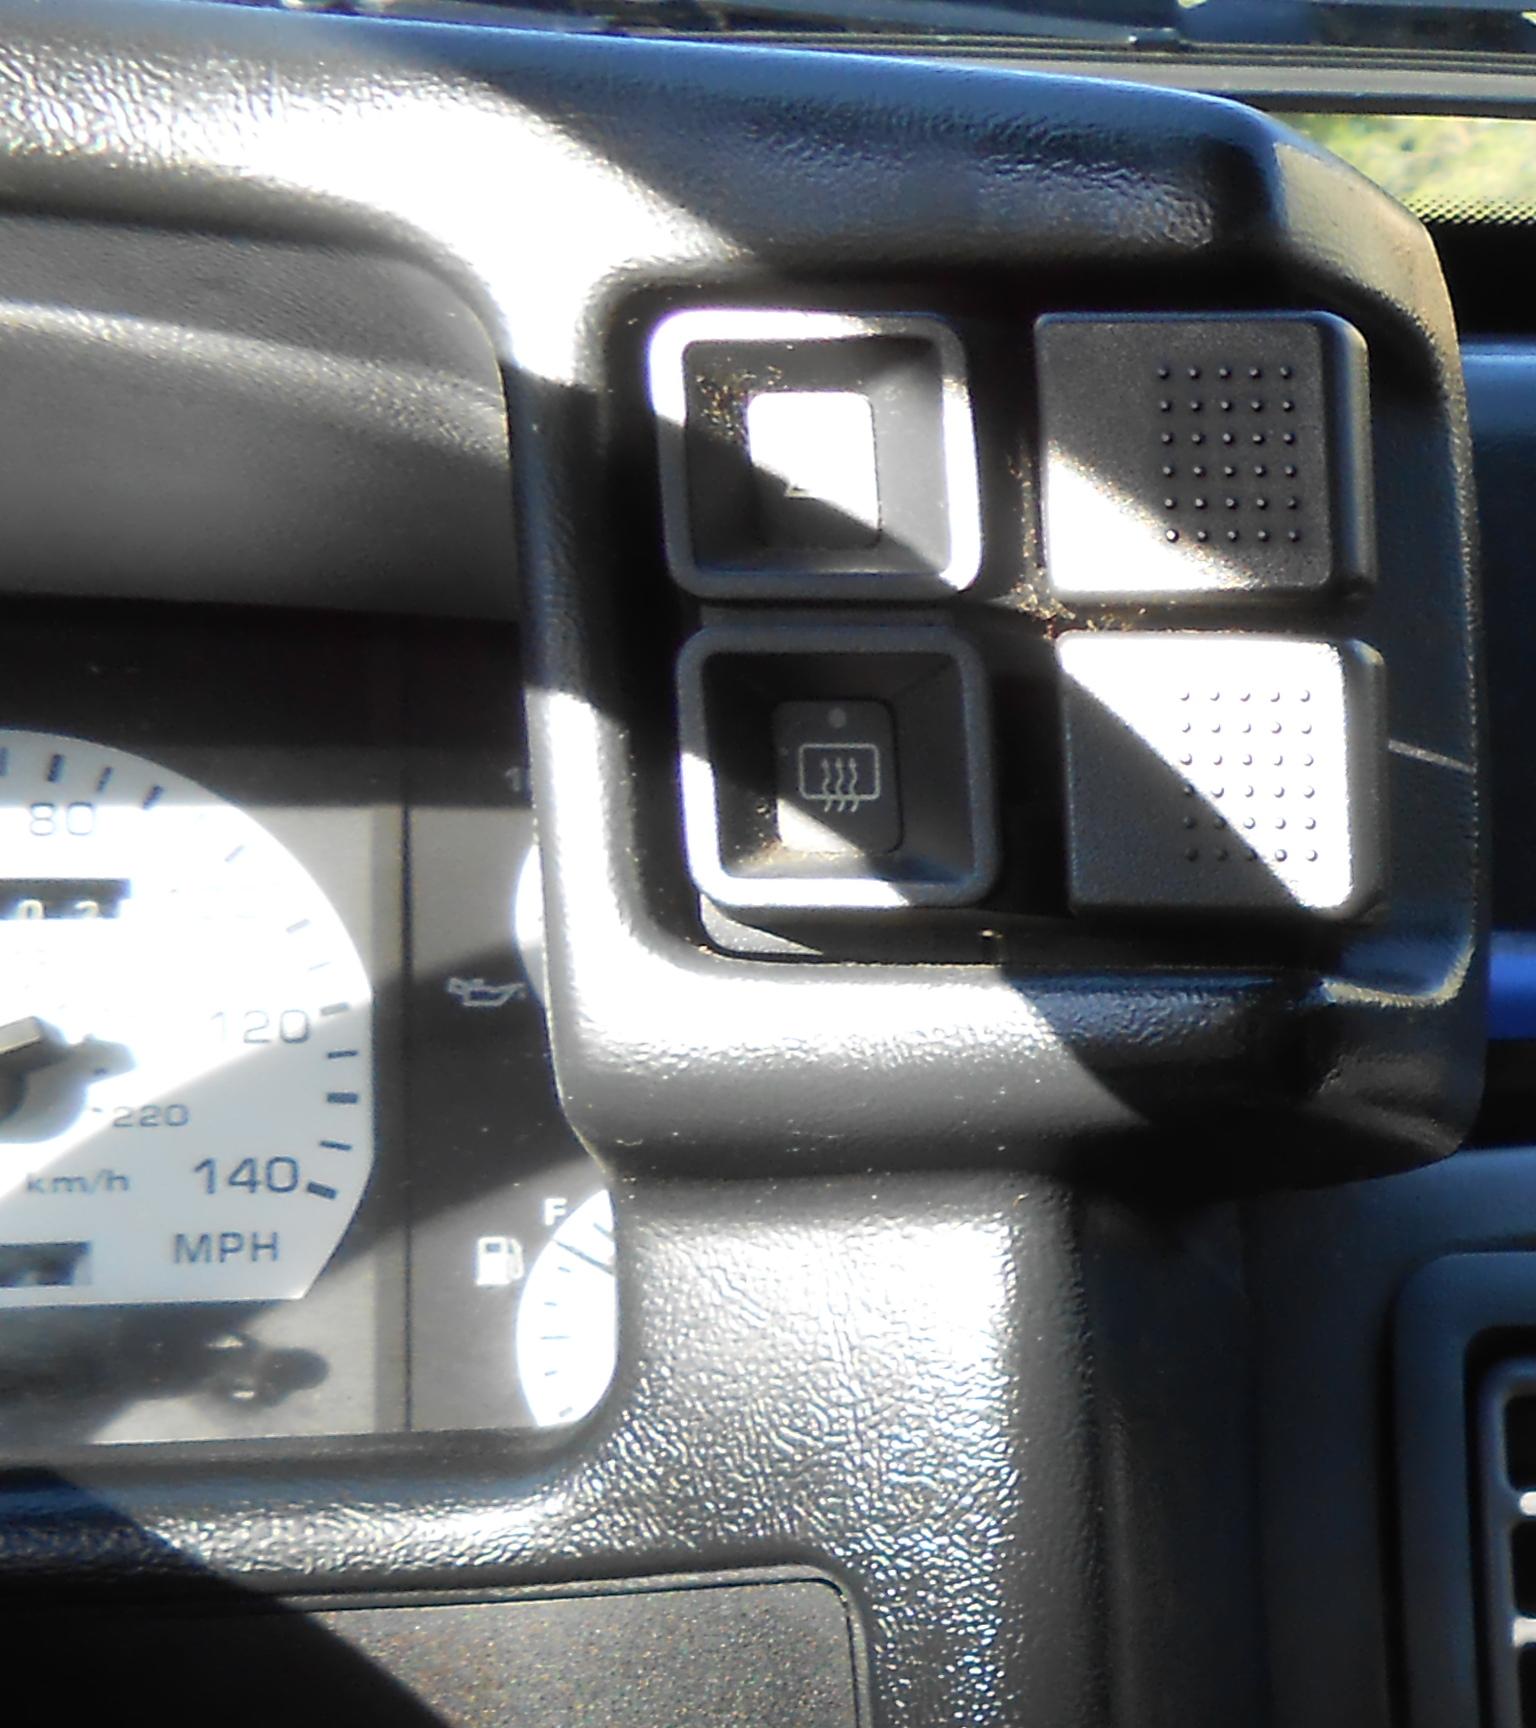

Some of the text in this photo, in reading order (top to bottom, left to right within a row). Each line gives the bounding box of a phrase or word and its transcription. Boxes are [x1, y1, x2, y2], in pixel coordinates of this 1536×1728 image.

[29, 802, 95, 836] 80
[212, 1008, 312, 1045] 120
[112, 1103, 191, 1128] 220
[26, 1169, 131, 1194] km/h
[193, 1156, 300, 1195] 140
[544, 1198, 568, 1226] F
[172, 1232, 281, 1264] MPH
